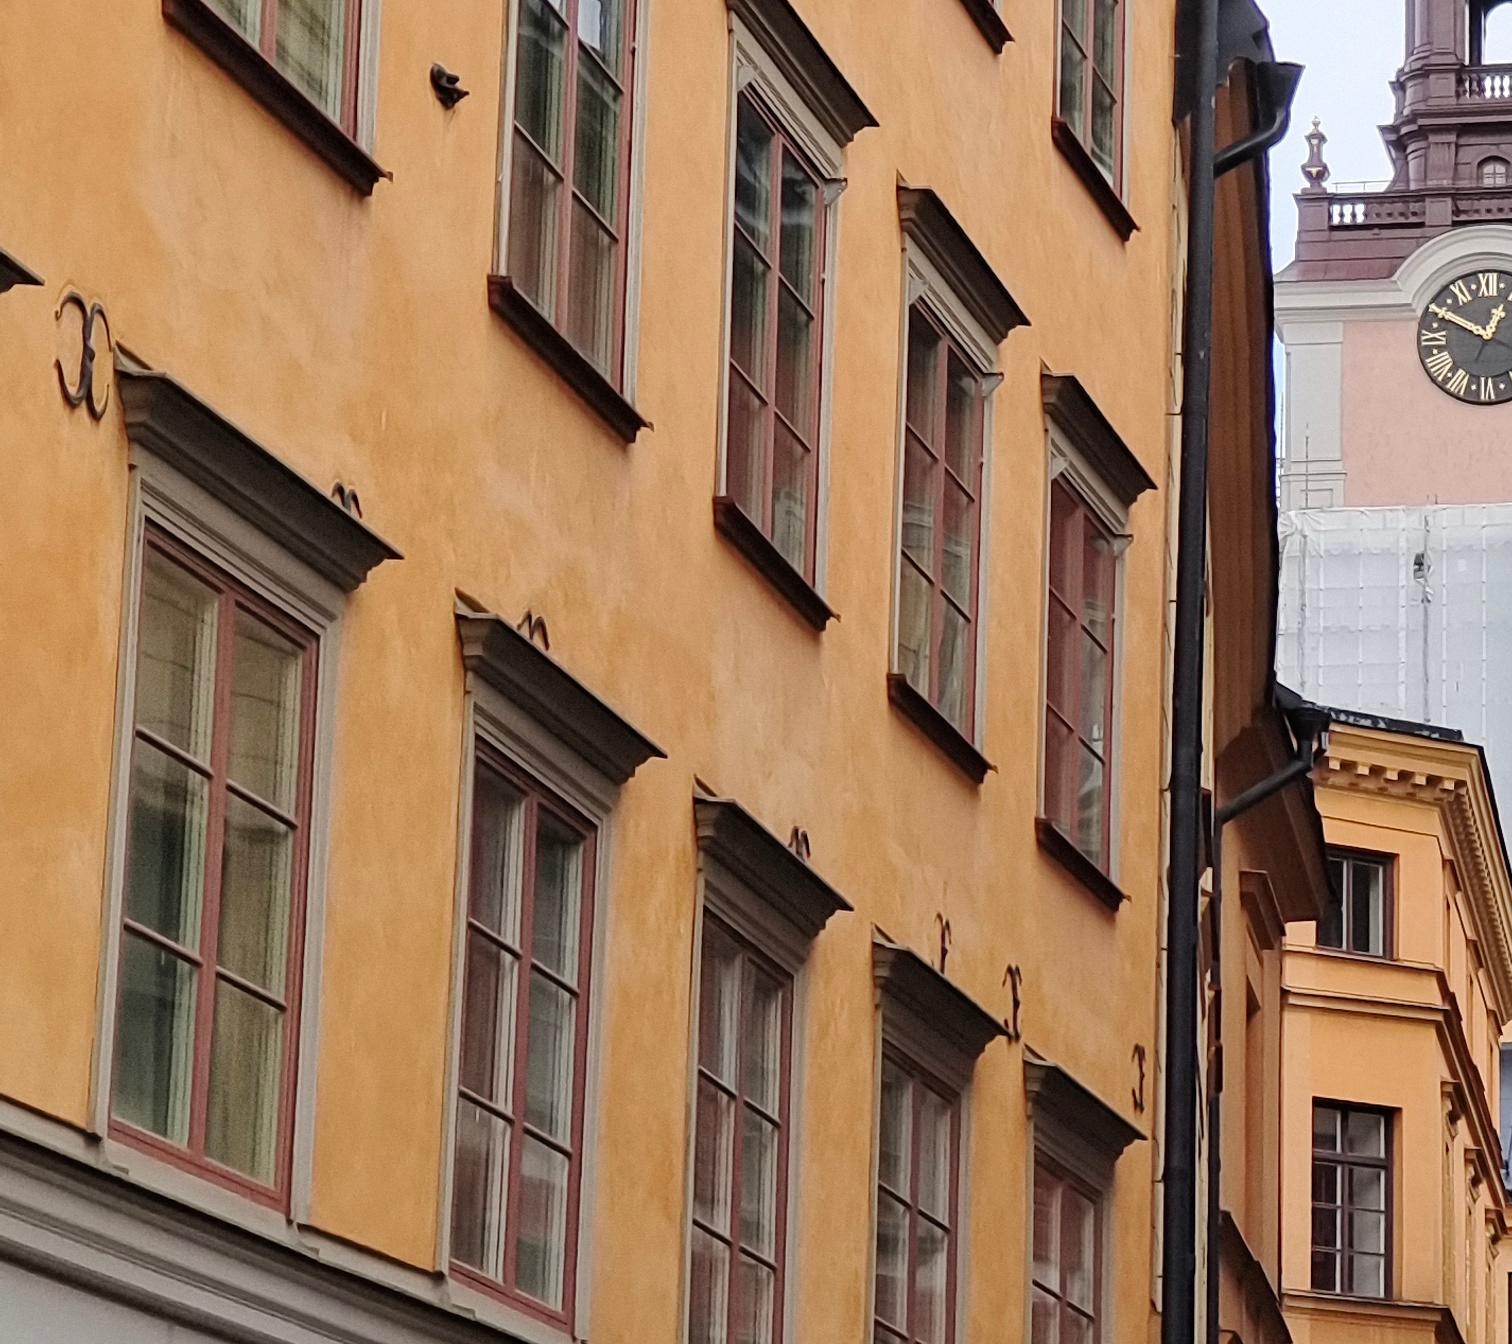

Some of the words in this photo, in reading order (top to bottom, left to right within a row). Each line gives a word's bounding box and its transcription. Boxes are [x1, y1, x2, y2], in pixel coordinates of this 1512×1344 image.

[1450, 279, 1472, 306] XI
[1478, 273, 1499, 297] XII
[1421, 330, 1447, 345] IX
[1425, 352, 1452, 381] VIII
[1448, 369, 1470, 396] VII
[1480, 377, 1495, 400] VI
